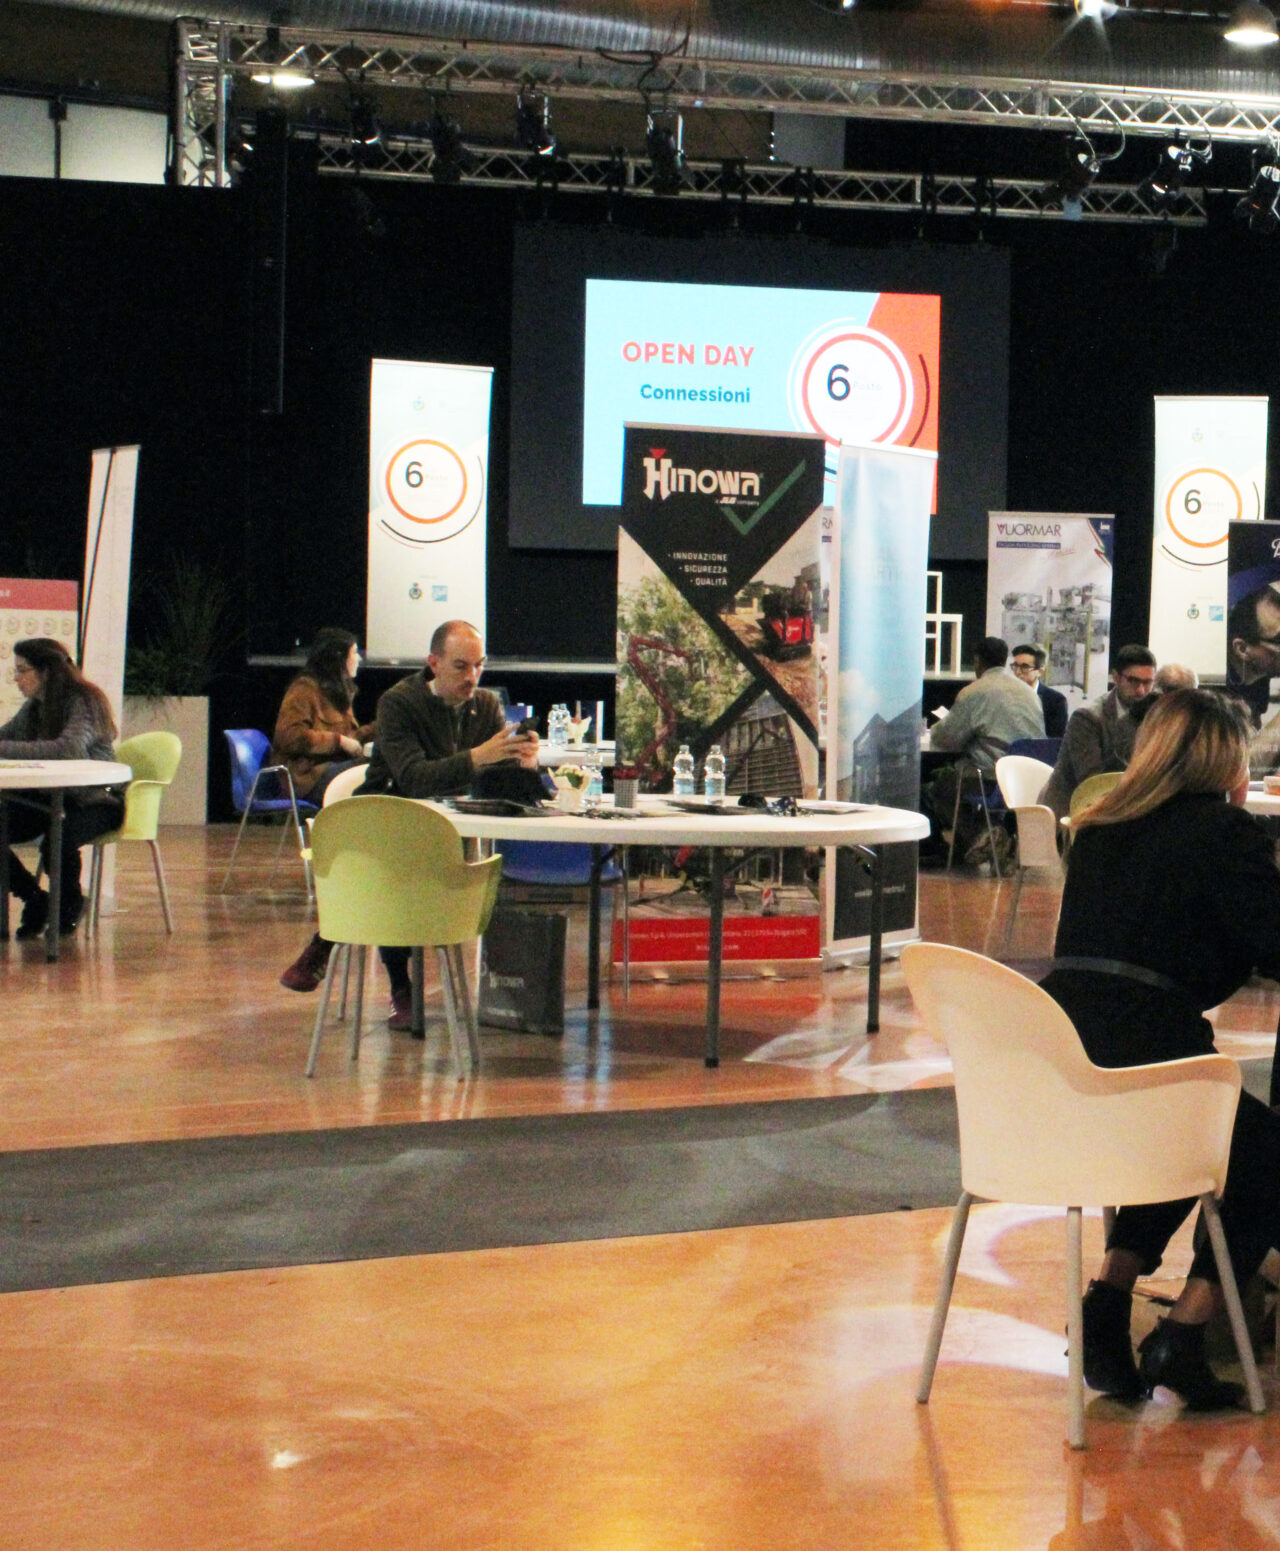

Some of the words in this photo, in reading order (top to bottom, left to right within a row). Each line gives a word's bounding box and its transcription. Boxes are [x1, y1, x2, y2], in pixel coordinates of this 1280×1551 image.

[622, 341, 695, 364] OPEN
[704, 345, 755, 367] DAY
[827, 364, 851, 401] 6
[640, 384, 751, 403] Connessioni
[405, 461, 424, 488] 6
[1184, 489, 1202, 515] 6
[997, 523, 1062, 536] VUORMAR
[673, 553, 728, 562] INNOVAZIONE
[684, 566, 729, 574] SICUREZZA
[695, 576, 728, 587] QUALITÀ
